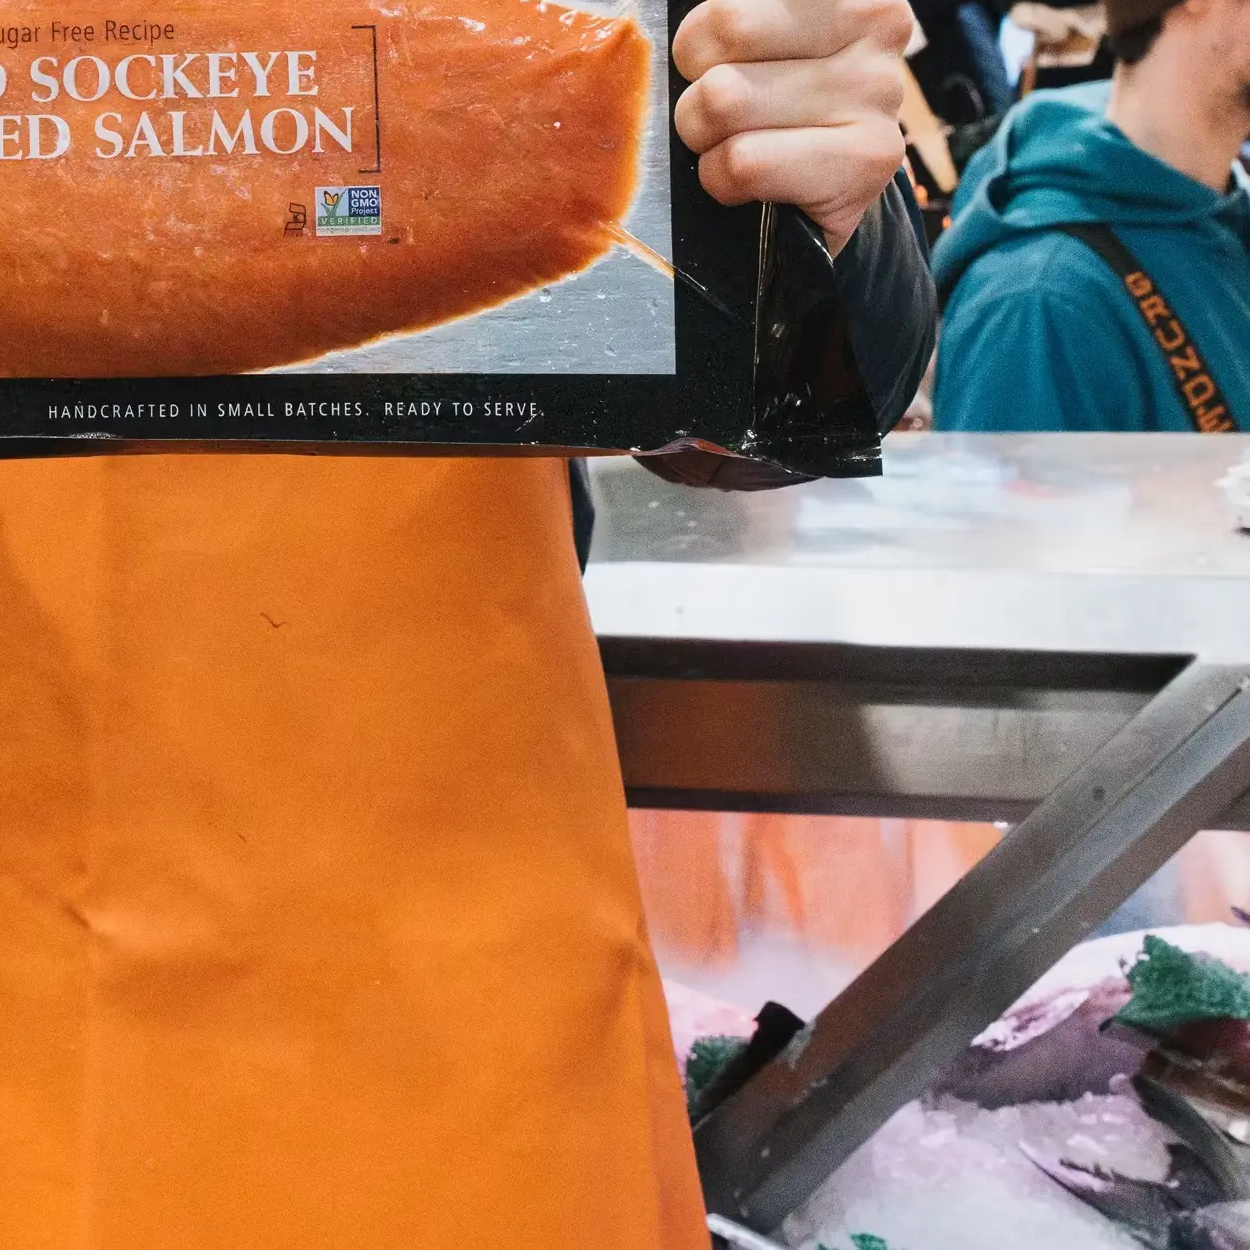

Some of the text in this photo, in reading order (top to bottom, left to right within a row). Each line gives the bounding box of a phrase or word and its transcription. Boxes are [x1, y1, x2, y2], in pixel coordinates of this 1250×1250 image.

[51, 21, 95, 42] Free
[105, 20, 175, 47] Recipe
[31, 50, 320, 104] SOCKEYE
[95, 106, 355, 161] SALMON
[351, 199, 378, 208] GMO
[351, 207, 378, 215] Project
[321, 216, 378, 225] VERIFIED
[48, 404, 180, 419] HANDCRAFTED
[190, 404, 207, 417] IN
[218, 403, 274, 417] SMALL
[285, 402, 370, 417] BATCHES.
[384, 402, 442, 417] READY
[452, 402, 473, 416] TO
